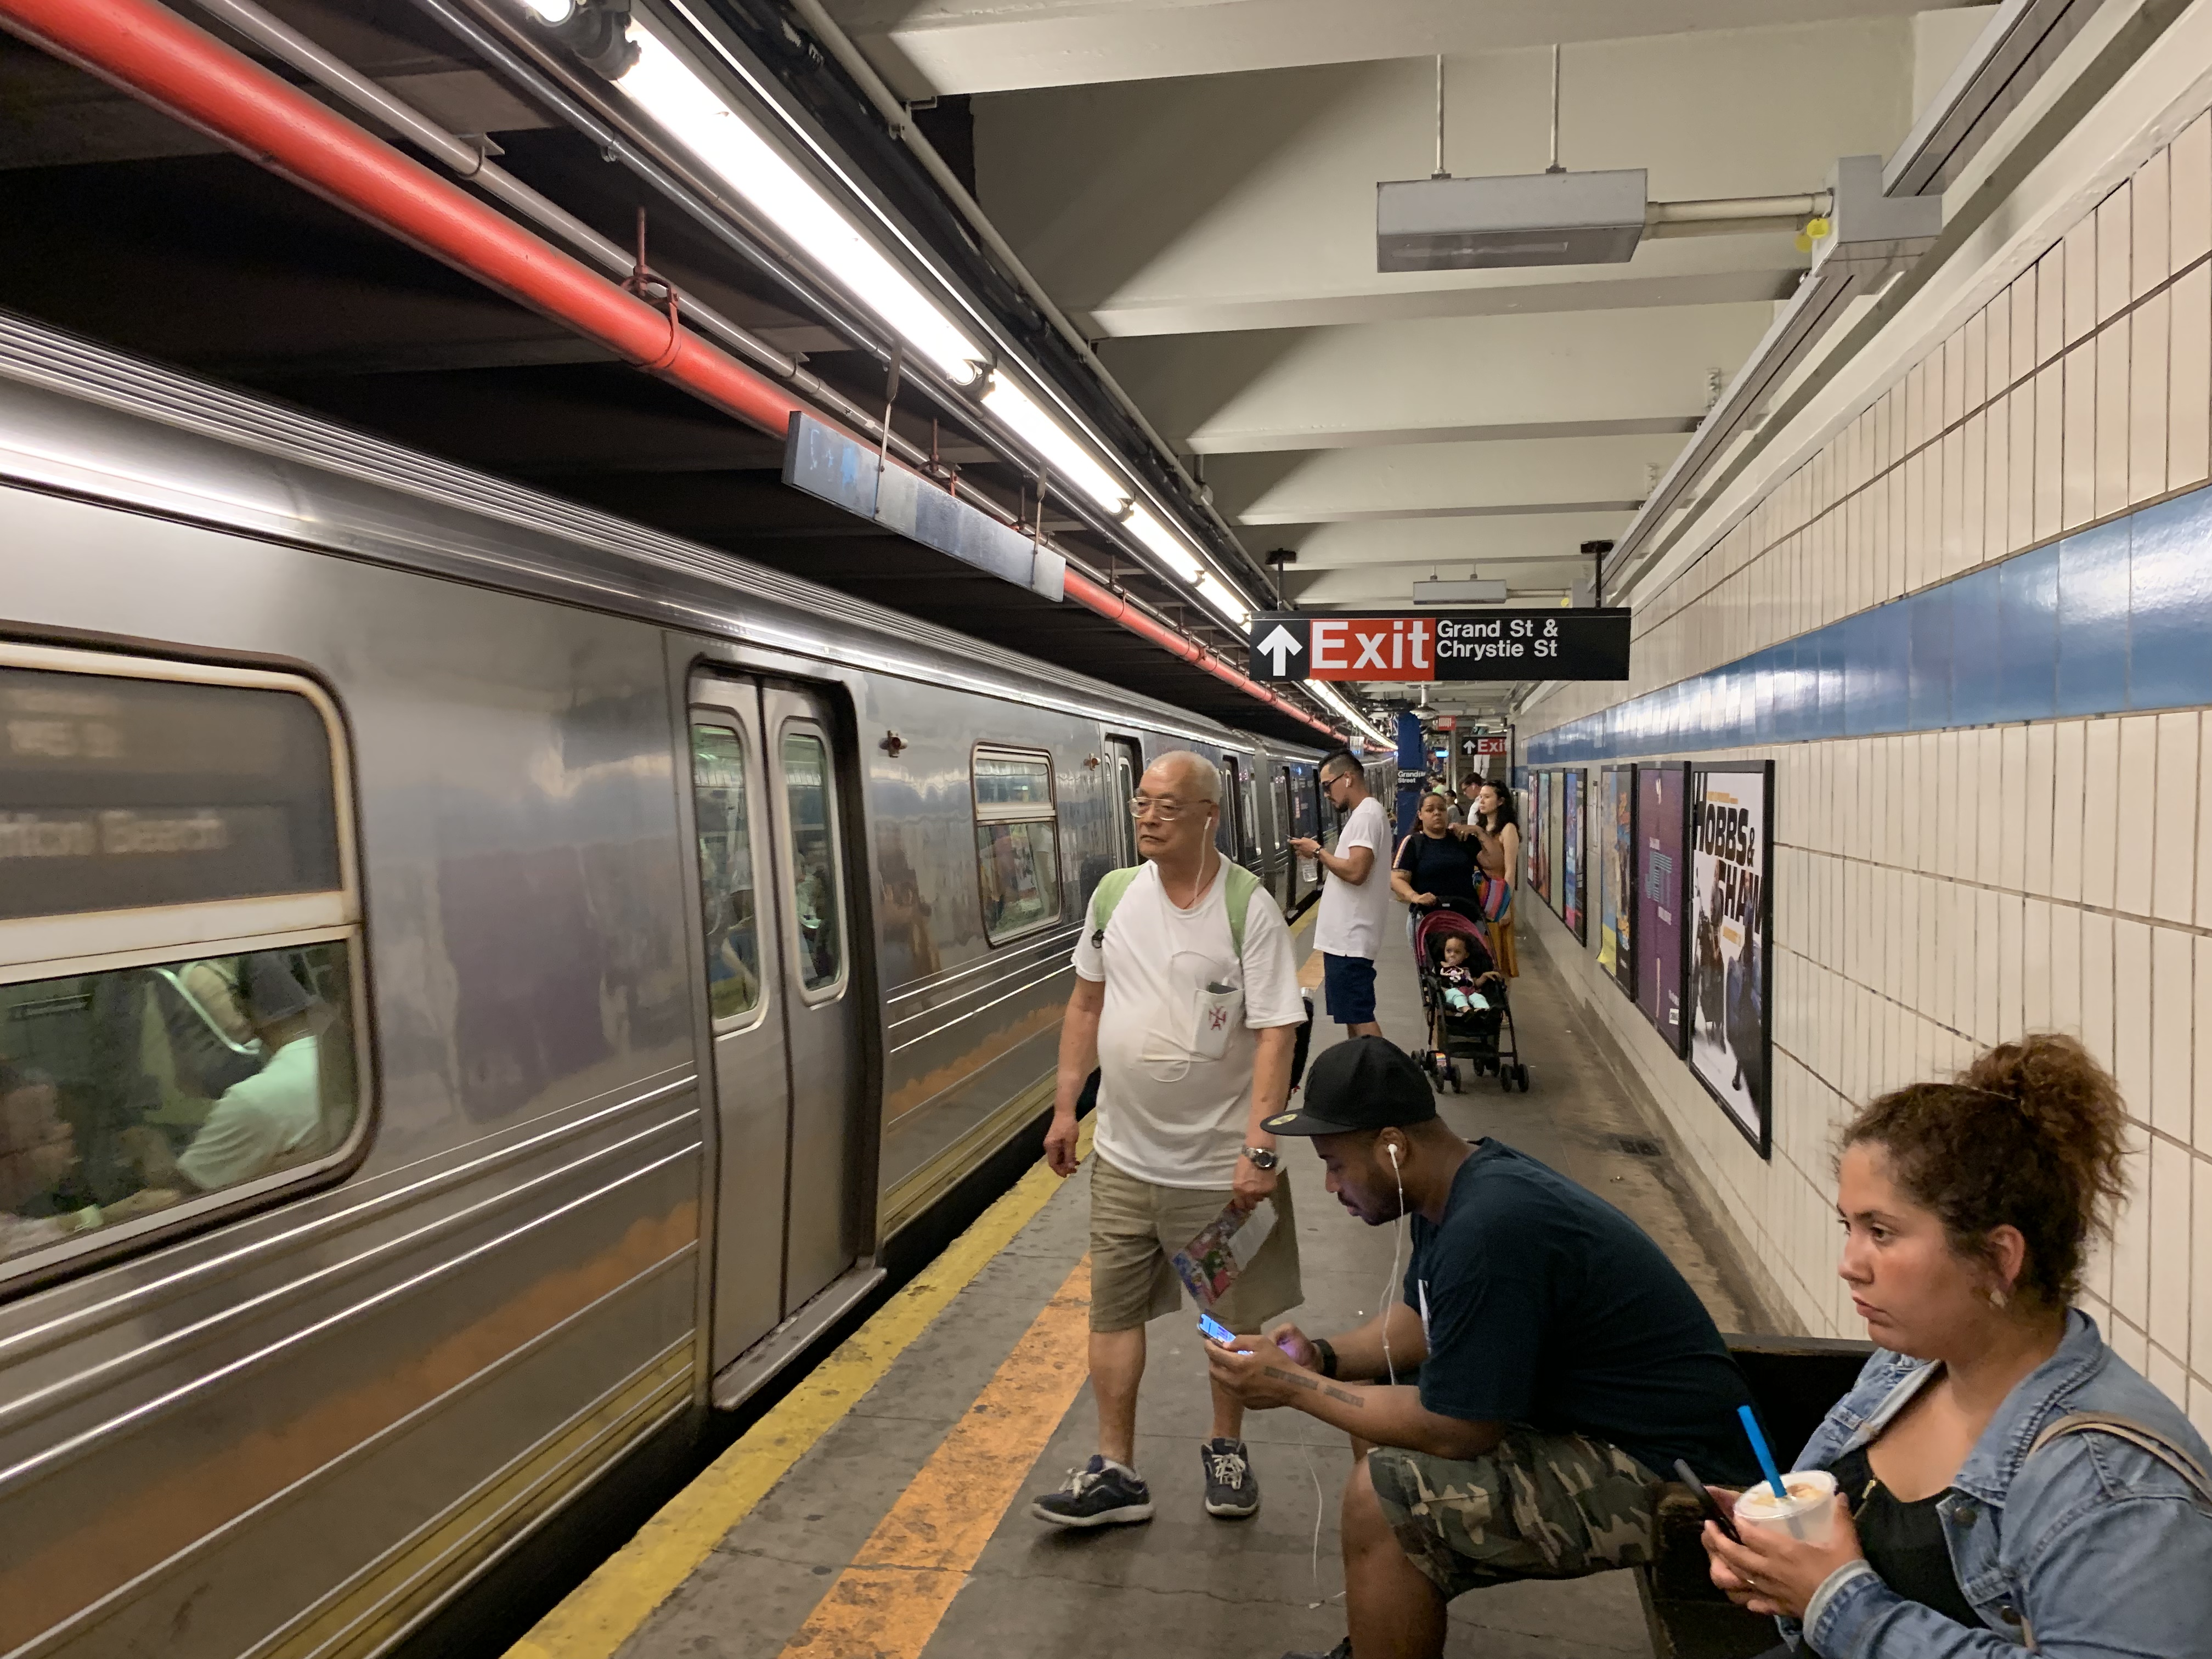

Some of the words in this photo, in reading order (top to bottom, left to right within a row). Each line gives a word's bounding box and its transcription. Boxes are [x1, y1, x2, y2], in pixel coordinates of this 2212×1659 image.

[1437, 620, 1500, 637] Grand
[1510, 619, 1534, 637] St
[1543, 619, 1558, 637] &
[1311, 620, 1430, 669] Exit
[1436, 640, 1524, 661] Chrystie
[1534, 639, 1558, 657] St
[1747, 827, 1755, 867] &
